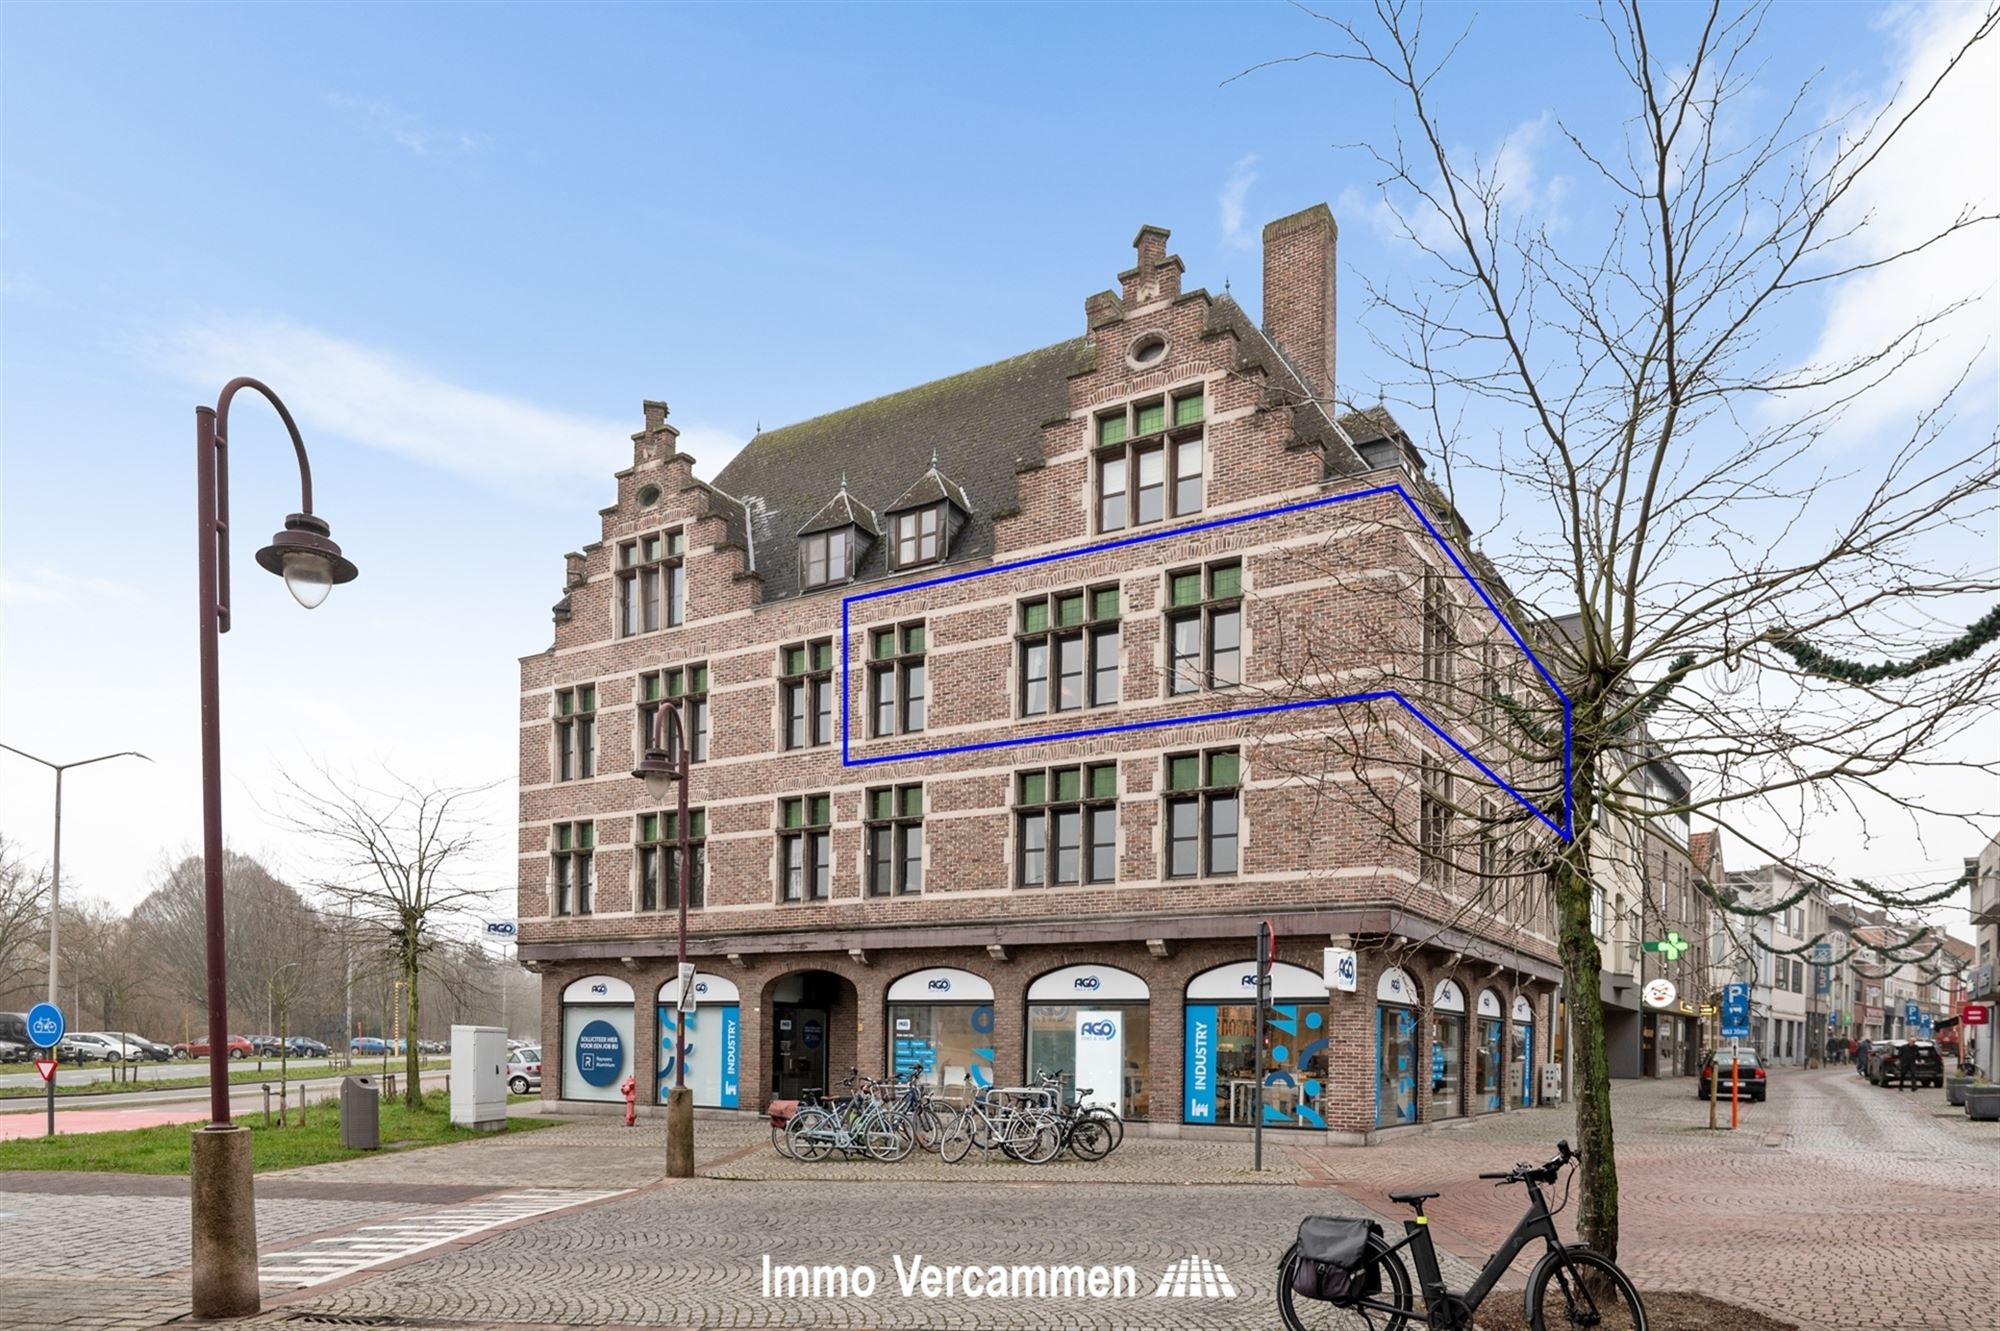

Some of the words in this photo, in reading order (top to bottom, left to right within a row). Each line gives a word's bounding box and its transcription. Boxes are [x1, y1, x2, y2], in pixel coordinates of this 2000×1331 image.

[487, 922, 515, 935] AGO
[1339, 956, 1354, 983] AGO
[928, 979, 951, 991] AGO
[1075, 977, 1099, 990] AGO
[1241, 975, 1258, 985] AG
[592, 984, 607, 994] AGO
[695, 983, 707, 993] GO
[1729, 986, 1742, 1003] P
[1909, 1007, 1916, 1015] P
[1081, 1020, 1116, 1039] AGO
[728, 1020, 736, 1074] INDUSTRY
[1195, 1021, 1207, 1090] INDUSTRY
